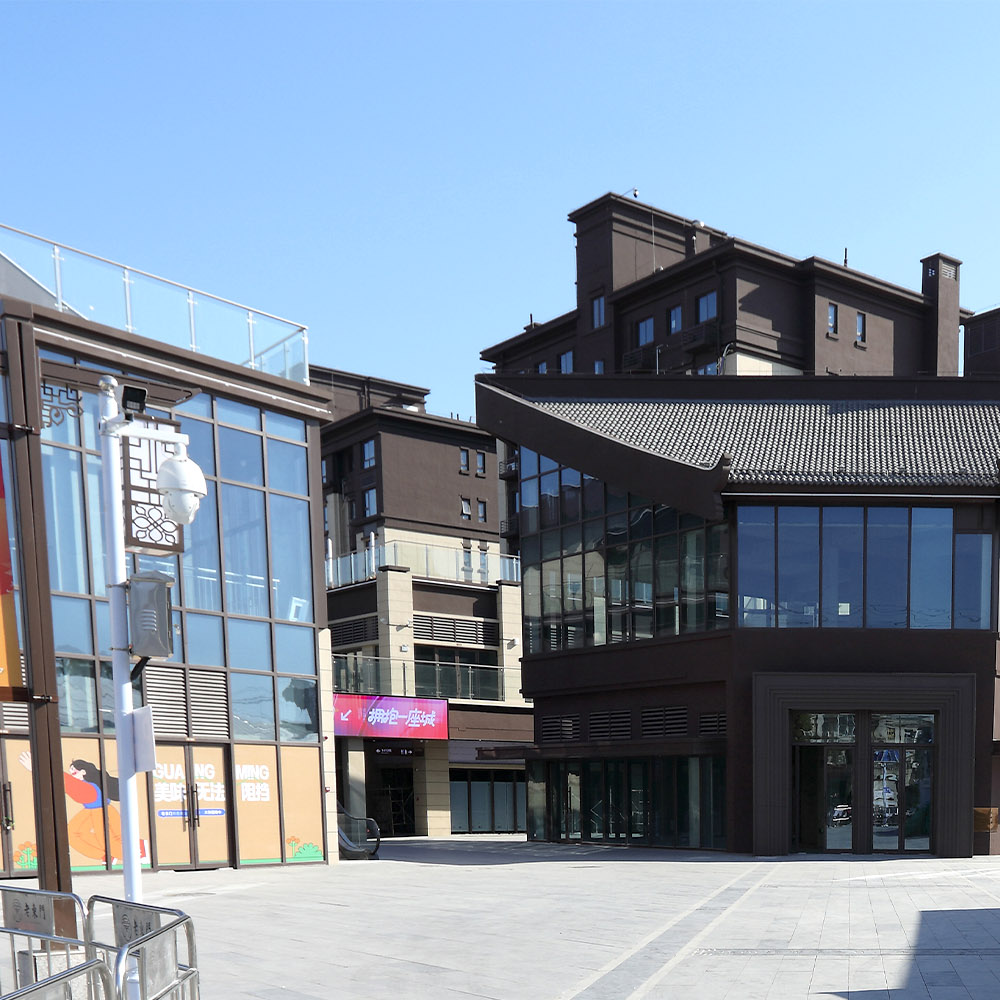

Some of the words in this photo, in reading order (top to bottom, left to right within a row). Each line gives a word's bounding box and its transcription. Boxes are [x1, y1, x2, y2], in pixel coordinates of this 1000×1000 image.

[367, 707, 436, 728] 拥抱一座城
[236, 764, 270, 780] MING
